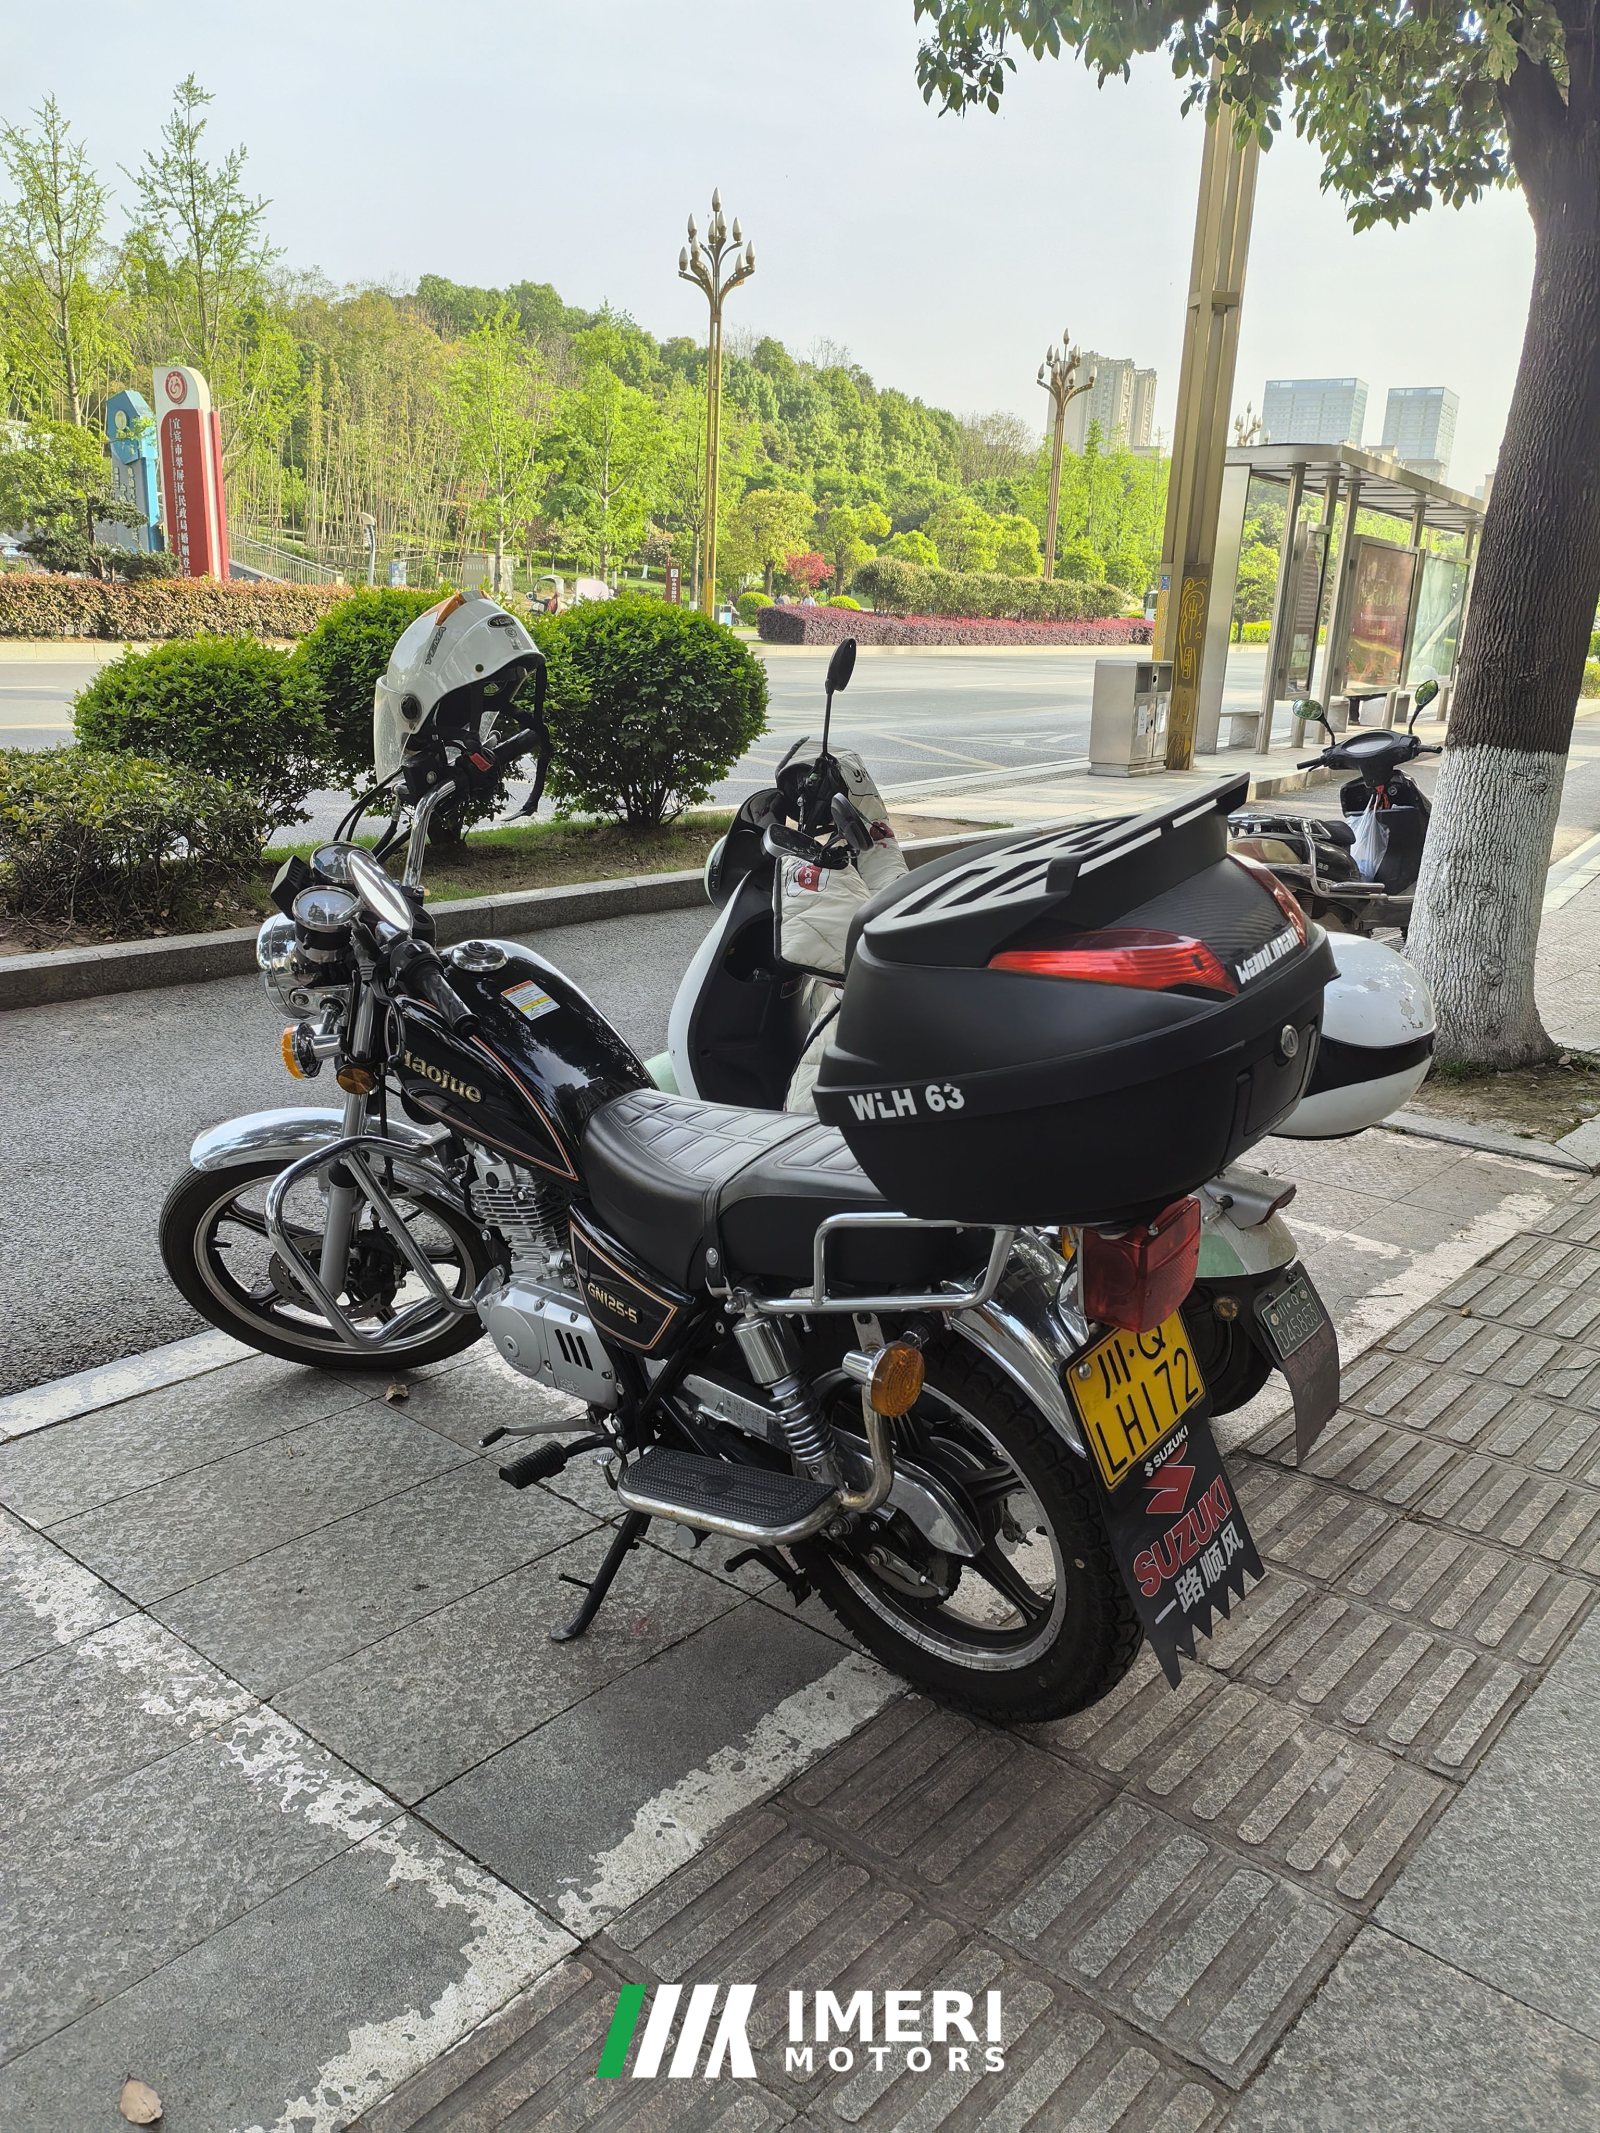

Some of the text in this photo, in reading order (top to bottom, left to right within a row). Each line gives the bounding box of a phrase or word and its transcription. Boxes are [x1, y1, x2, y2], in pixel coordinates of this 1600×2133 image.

[925, 1083, 965, 1112] 63
[588, 1282, 638, 1324] GN125-5
[1095, 1347, 1198, 1475] LH172
[1153, 1425, 1189, 1468] SUZUKI
[1133, 1474, 1233, 1598] SUZUKI
[1155, 1521, 1244, 1625] 一路顺风
